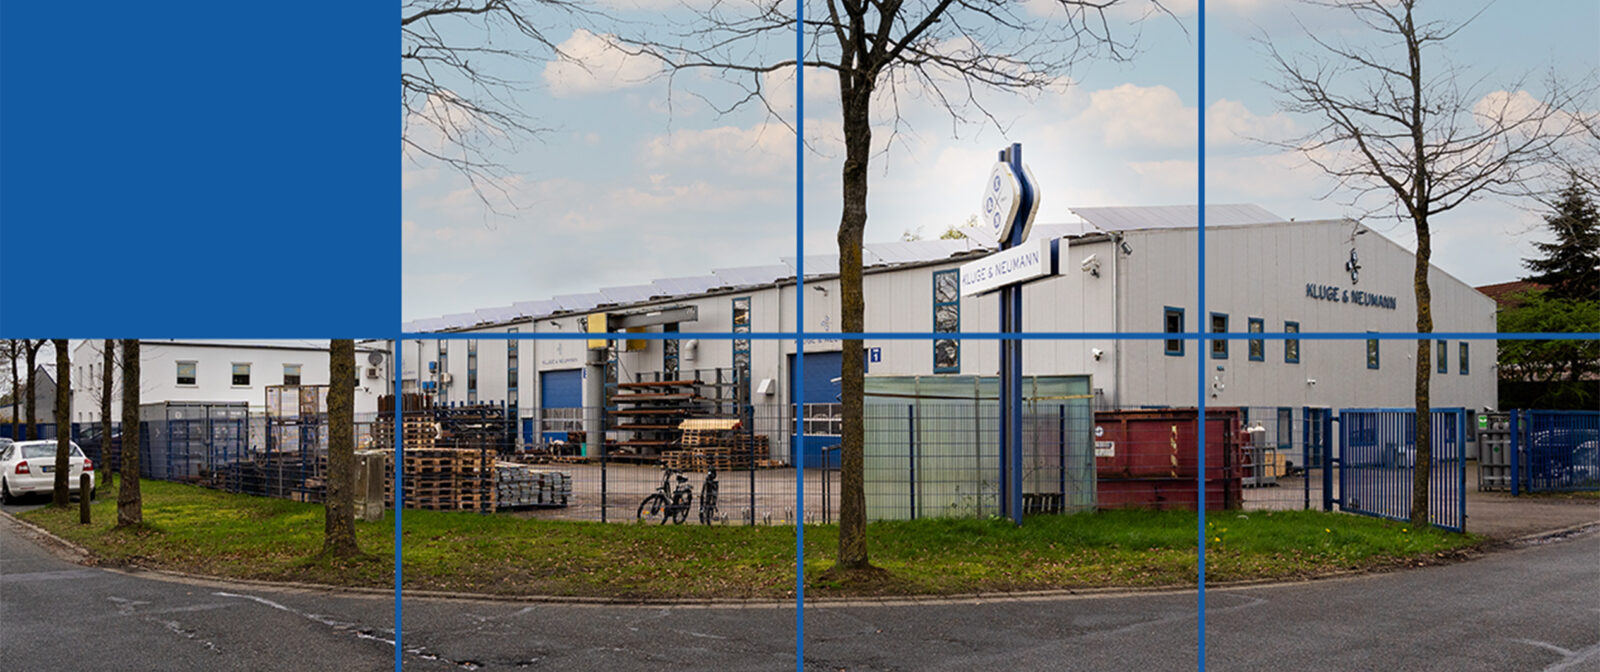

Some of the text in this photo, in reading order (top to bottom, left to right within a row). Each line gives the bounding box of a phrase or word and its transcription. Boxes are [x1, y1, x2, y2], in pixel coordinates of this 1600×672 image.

[962, 267, 986, 285] KLUGE
[995, 250, 1040, 275] NEUMANN
[1306, 283, 1396, 310] KLUGE & NEUMANN
